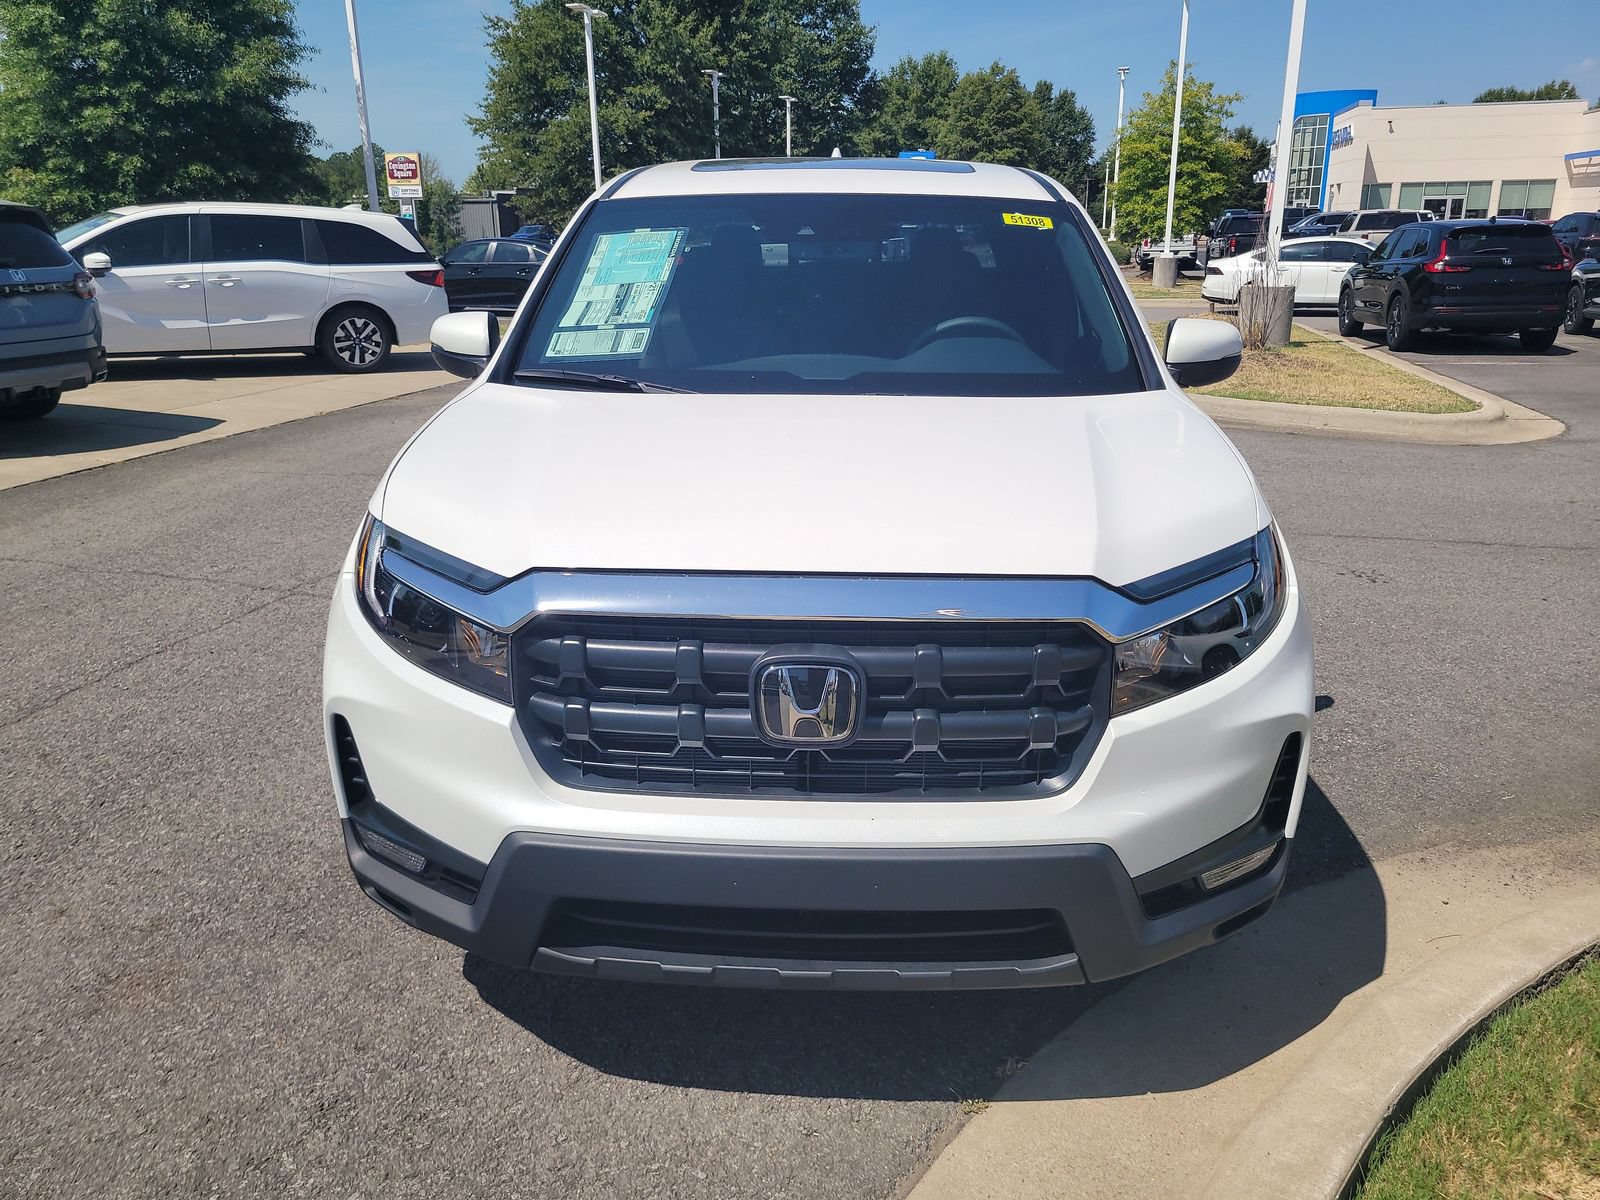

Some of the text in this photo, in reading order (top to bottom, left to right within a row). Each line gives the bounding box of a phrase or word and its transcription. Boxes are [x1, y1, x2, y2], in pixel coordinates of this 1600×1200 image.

[393, 169, 412, 178] Square
[1010, 215, 1046, 227] 51308
[669, 235, 682, 258] HONDA
